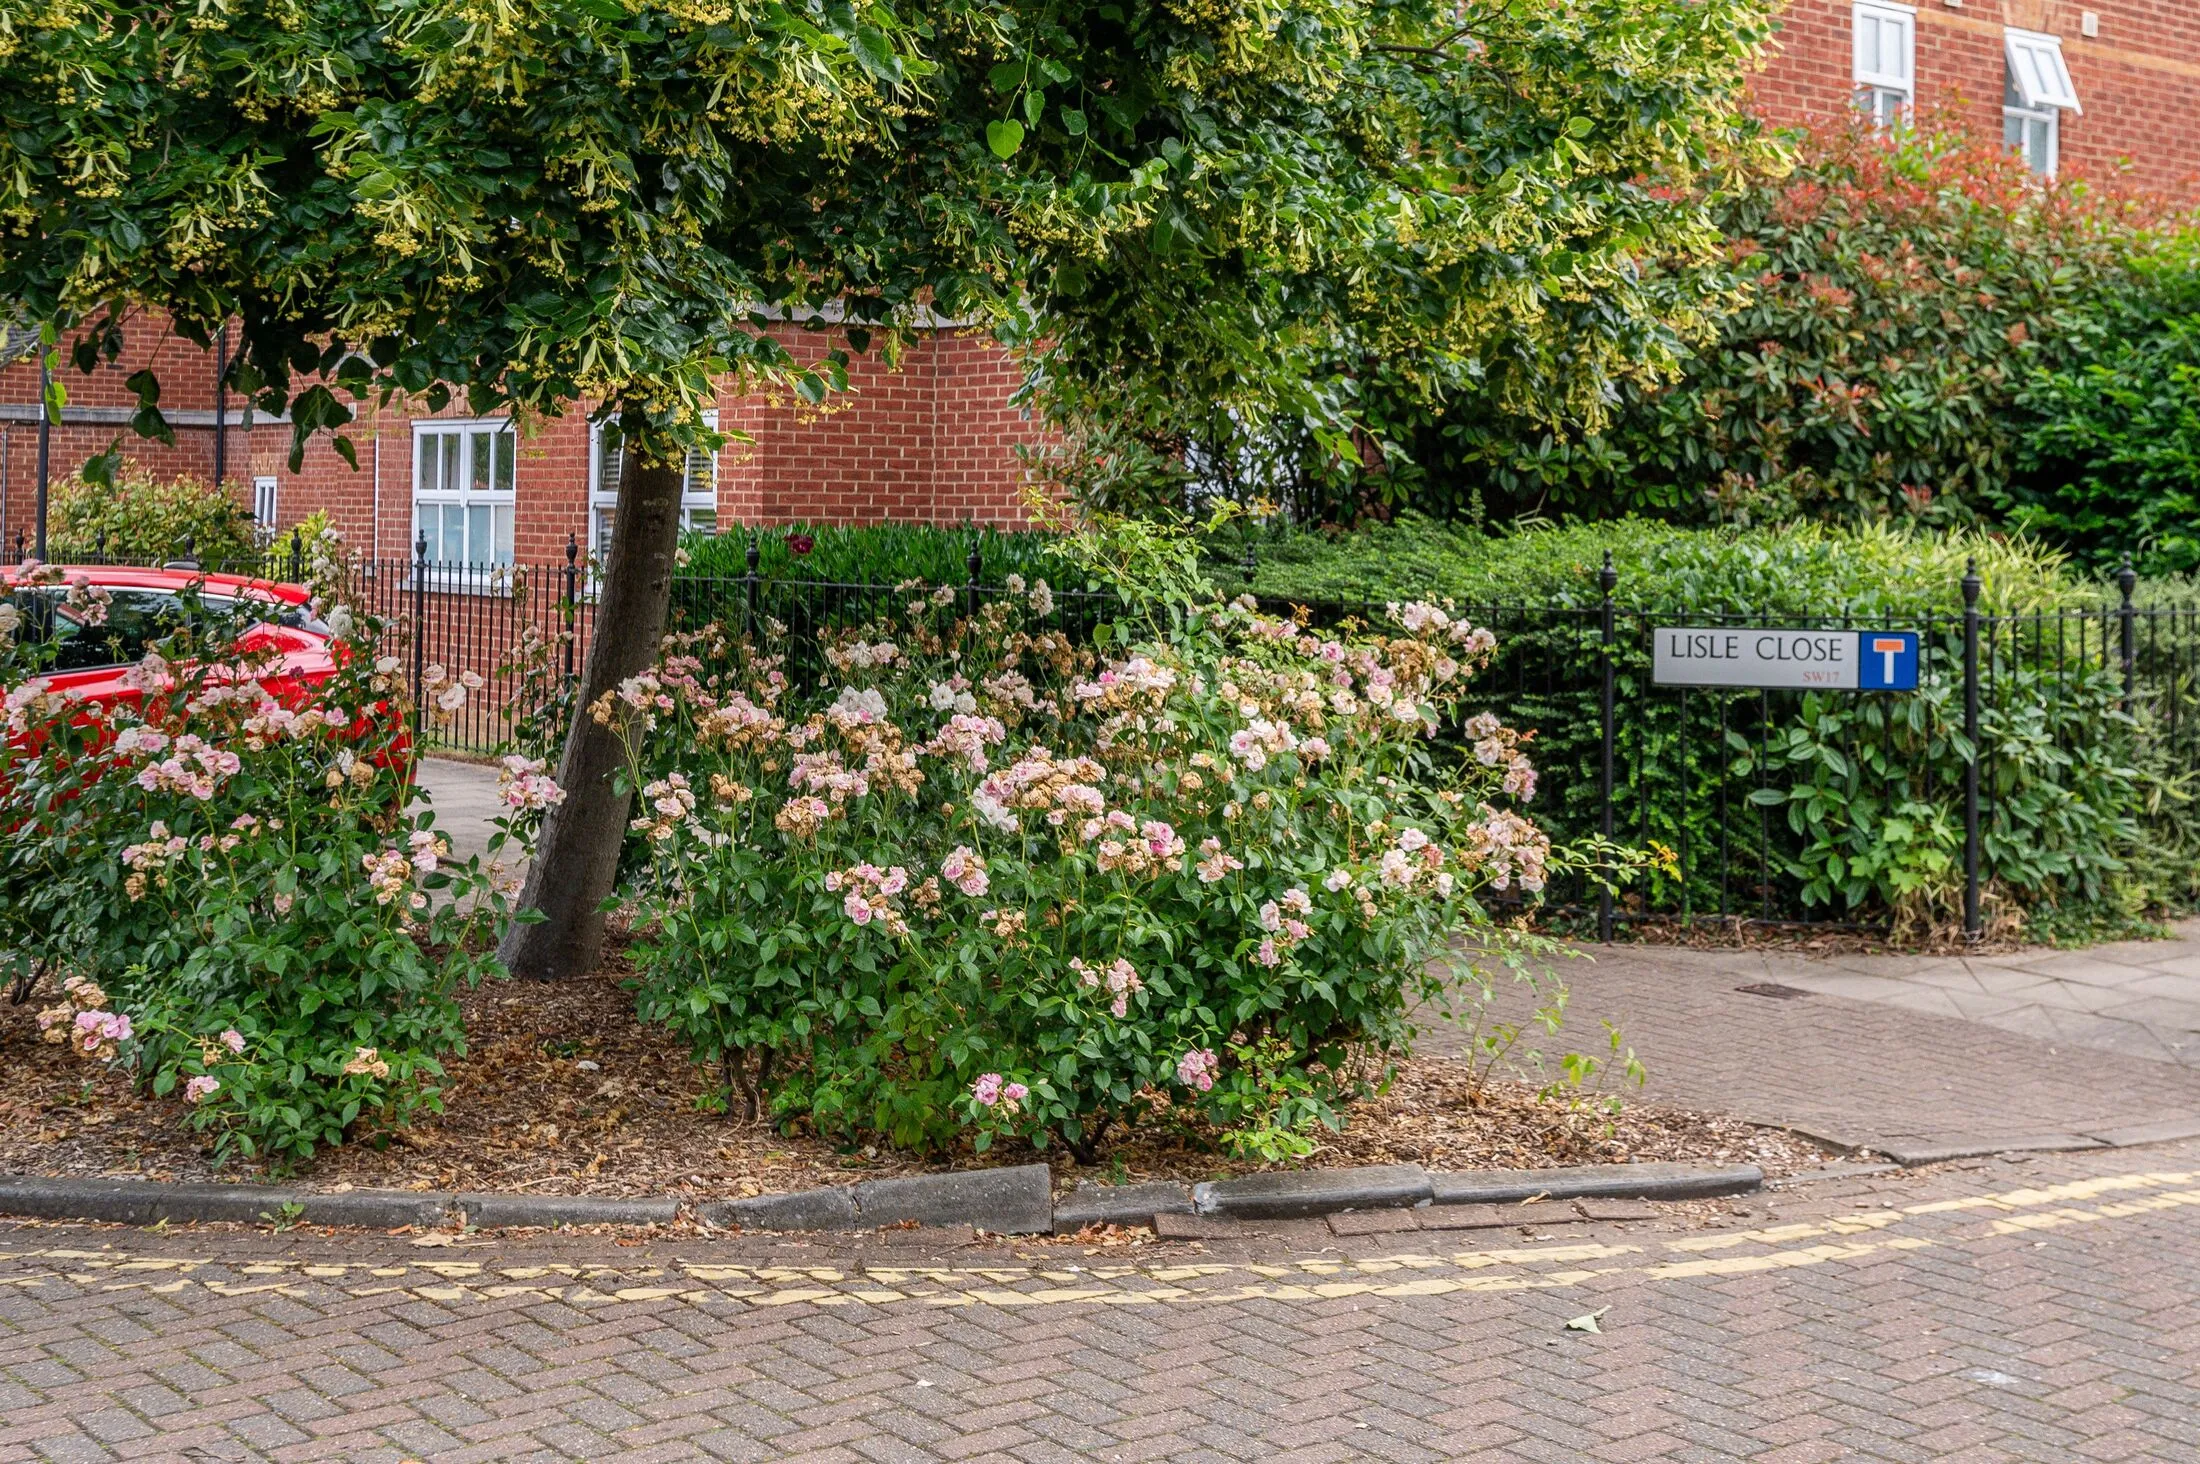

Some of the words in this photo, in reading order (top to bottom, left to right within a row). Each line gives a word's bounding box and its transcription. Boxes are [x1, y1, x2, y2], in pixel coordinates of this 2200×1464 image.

[1670, 634, 1740, 660] LISLE
[1755, 636, 1843, 662] CLOSE
[1802, 671, 1841, 683] SW17
